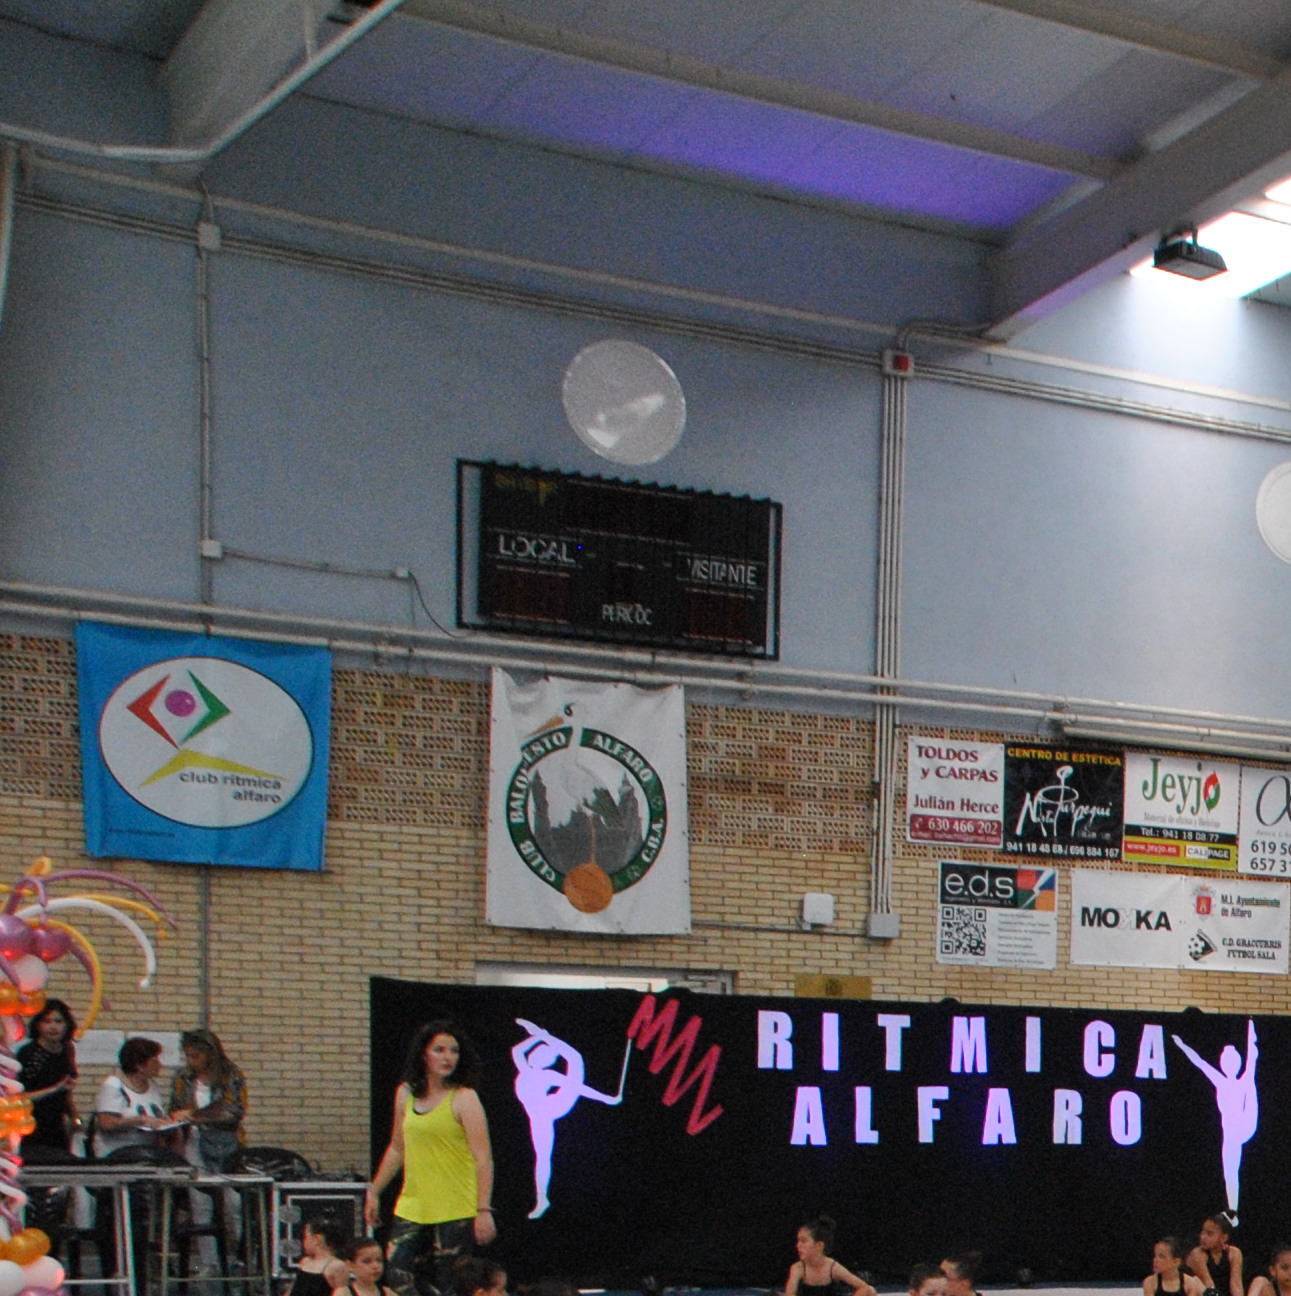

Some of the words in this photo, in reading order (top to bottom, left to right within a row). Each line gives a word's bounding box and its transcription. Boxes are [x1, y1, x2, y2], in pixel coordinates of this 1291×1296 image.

[499, 535, 575, 564] LOCAL
[916, 745, 979, 762] TOLDOS
[1007, 747, 1053, 760] CENTRO
[1055, 751, 1070, 760] DE
[179, 771, 218, 784] club
[920, 767, 930, 780] y
[935, 766, 999, 783] CARPAS
[1142, 758, 1221, 815] Jeyjo
[233, 790, 282, 804] alfaro
[914, 794, 955, 811] Julián
[961, 798, 999, 814] Herce
[519, 839, 556, 882] CLUB
[592, 734, 653, 782] ALFARO
[928, 818, 950, 831] 630
[953, 820, 974, 833] 466
[978, 821, 998, 835] 202
[1162, 829, 1179, 839] 941
[1182, 831, 1193, 840] 18
[1006, 842, 1023, 852] 941
[1026, 843, 1037, 852] 18
[1187, 847, 1229, 859] CALIPAGE
[1251, 840, 1276, 854] 619
[1250, 857, 1275, 871] 657
[945, 870, 1014, 898] e.d.s
[1221, 907, 1229, 917] de
[1231, 907, 1252, 918] Alfaro
[757, 1009, 1168, 1080] RITMICA
[790, 1085, 1142, 1146] ALFARO
